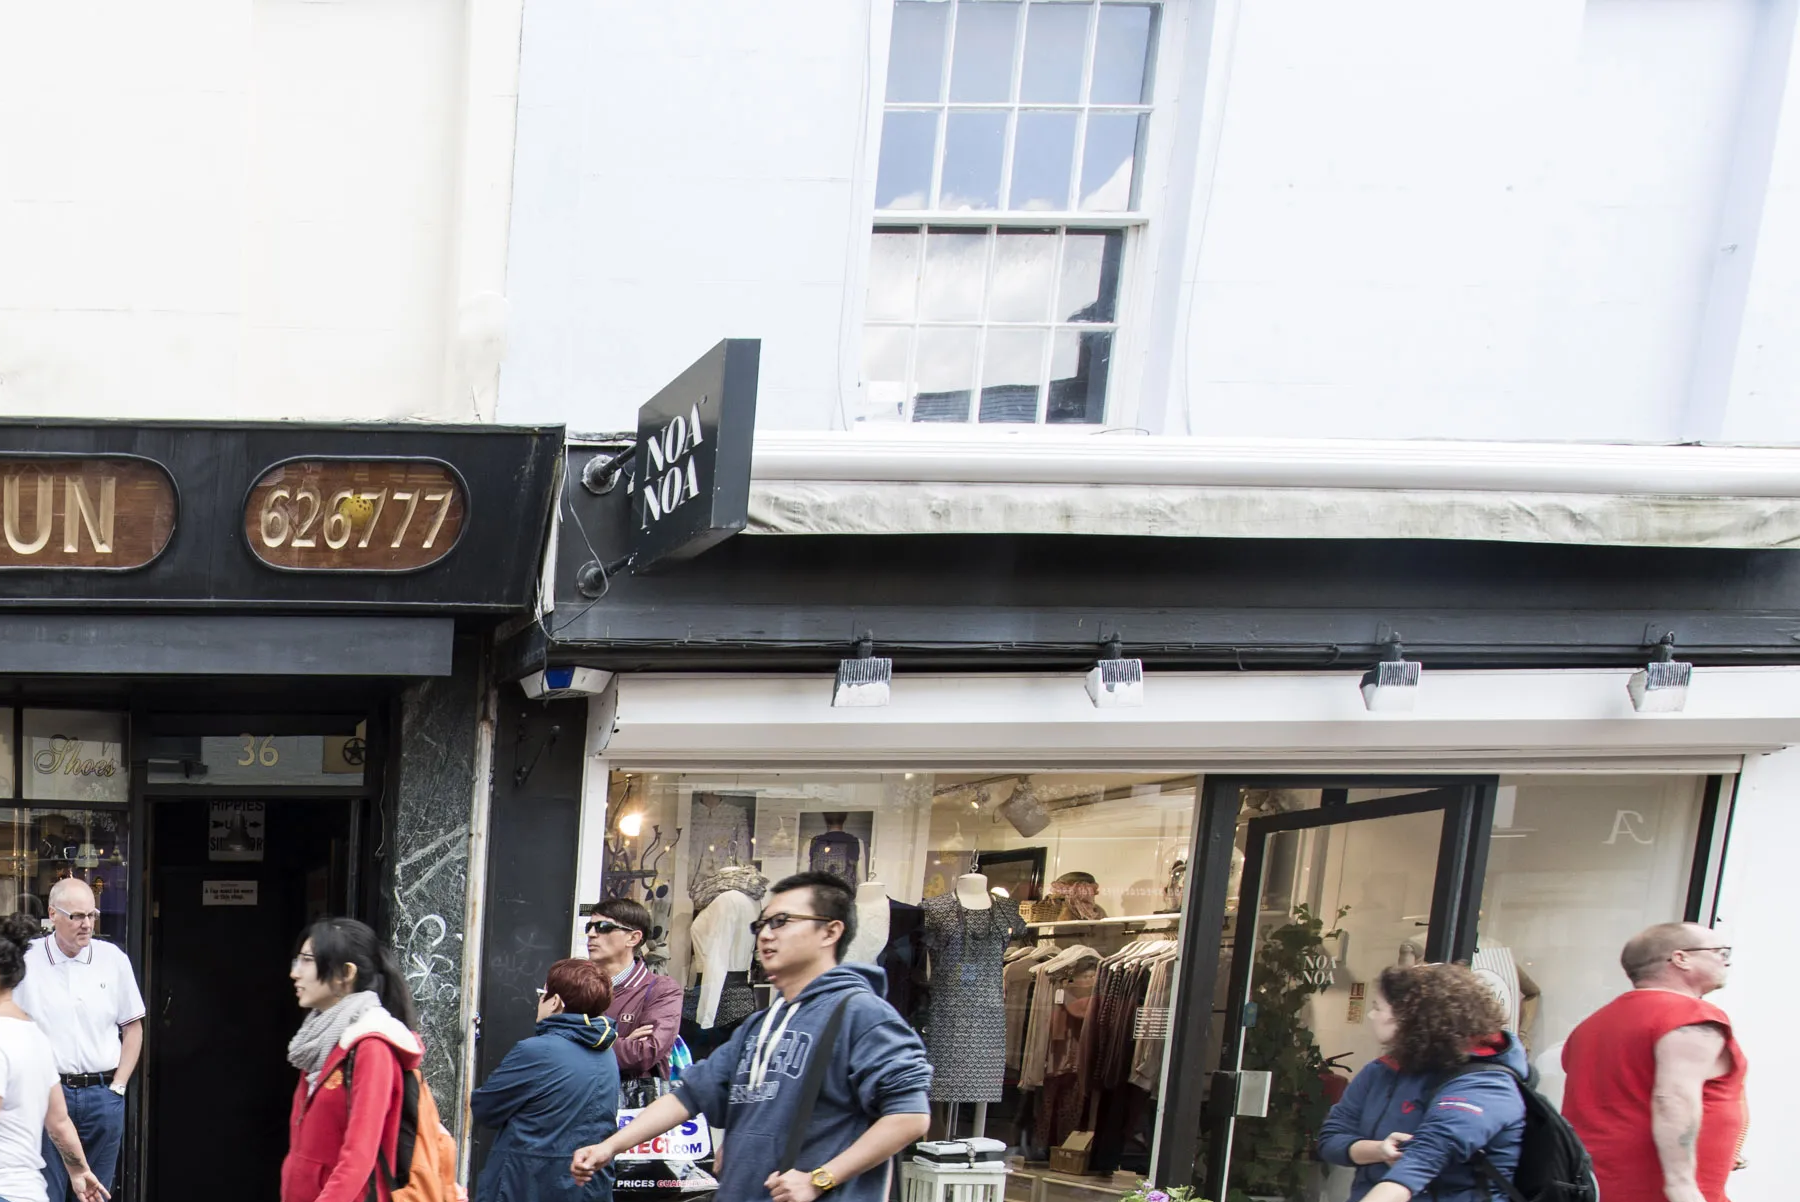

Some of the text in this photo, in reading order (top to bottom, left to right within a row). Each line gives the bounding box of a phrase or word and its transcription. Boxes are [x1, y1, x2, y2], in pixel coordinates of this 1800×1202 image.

[645, 401, 704, 480] NOA
[641, 453, 700, 530] NOA
[259, 484, 454, 549] 626777
[34, 732, 118, 778] Shoes
[237, 733, 280, 768] 36
[1302, 970, 1335, 984] NOA
[1303, 955, 1337, 969] NOA
[617, 1180, 655, 1188] PRICES
